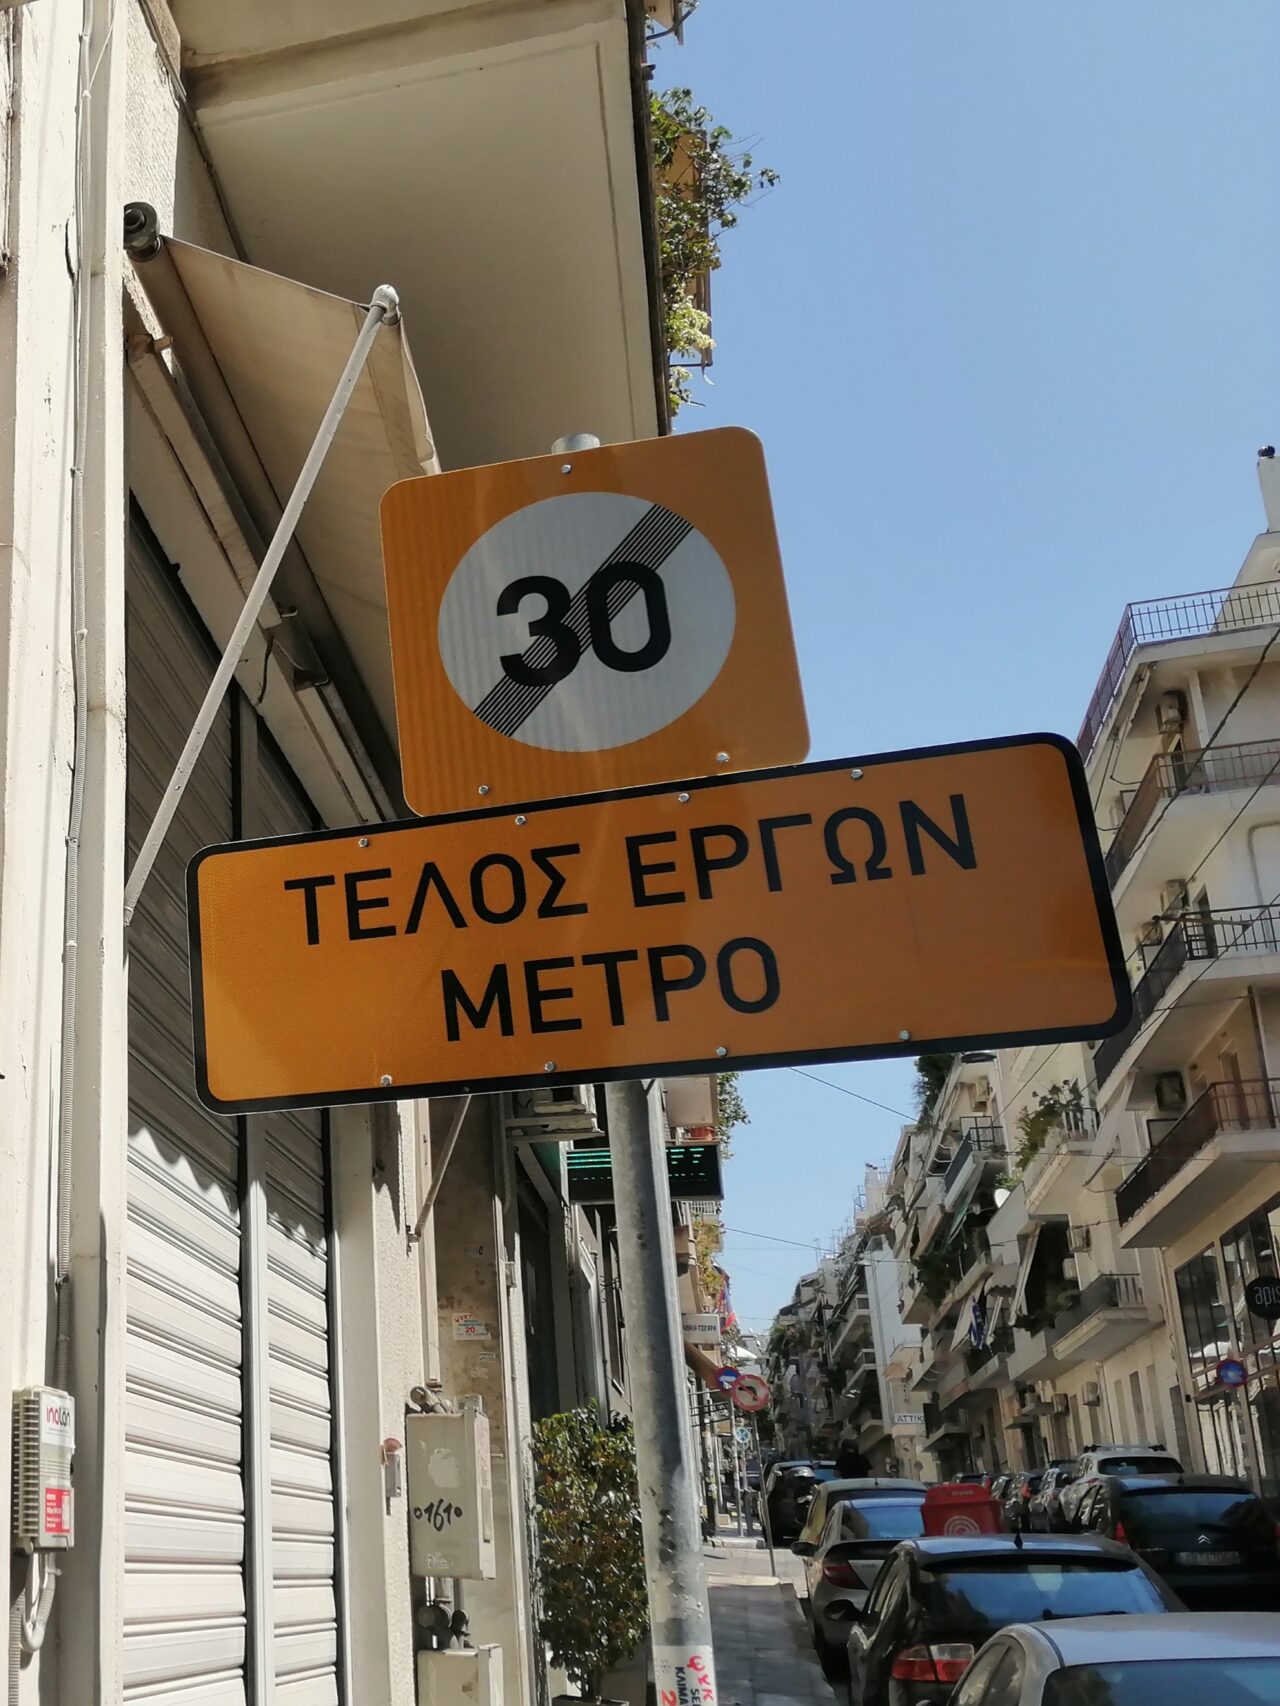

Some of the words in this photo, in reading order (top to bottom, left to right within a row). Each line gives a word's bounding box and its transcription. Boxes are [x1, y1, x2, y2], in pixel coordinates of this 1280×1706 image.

[497, 561, 672, 687] 30
[283, 843, 588, 946] ΤΕΛΟΣ
[625, 794, 978, 908] ΕΡΓΩΝ
[440, 936, 780, 1043] ΜΕΤΡΟ
